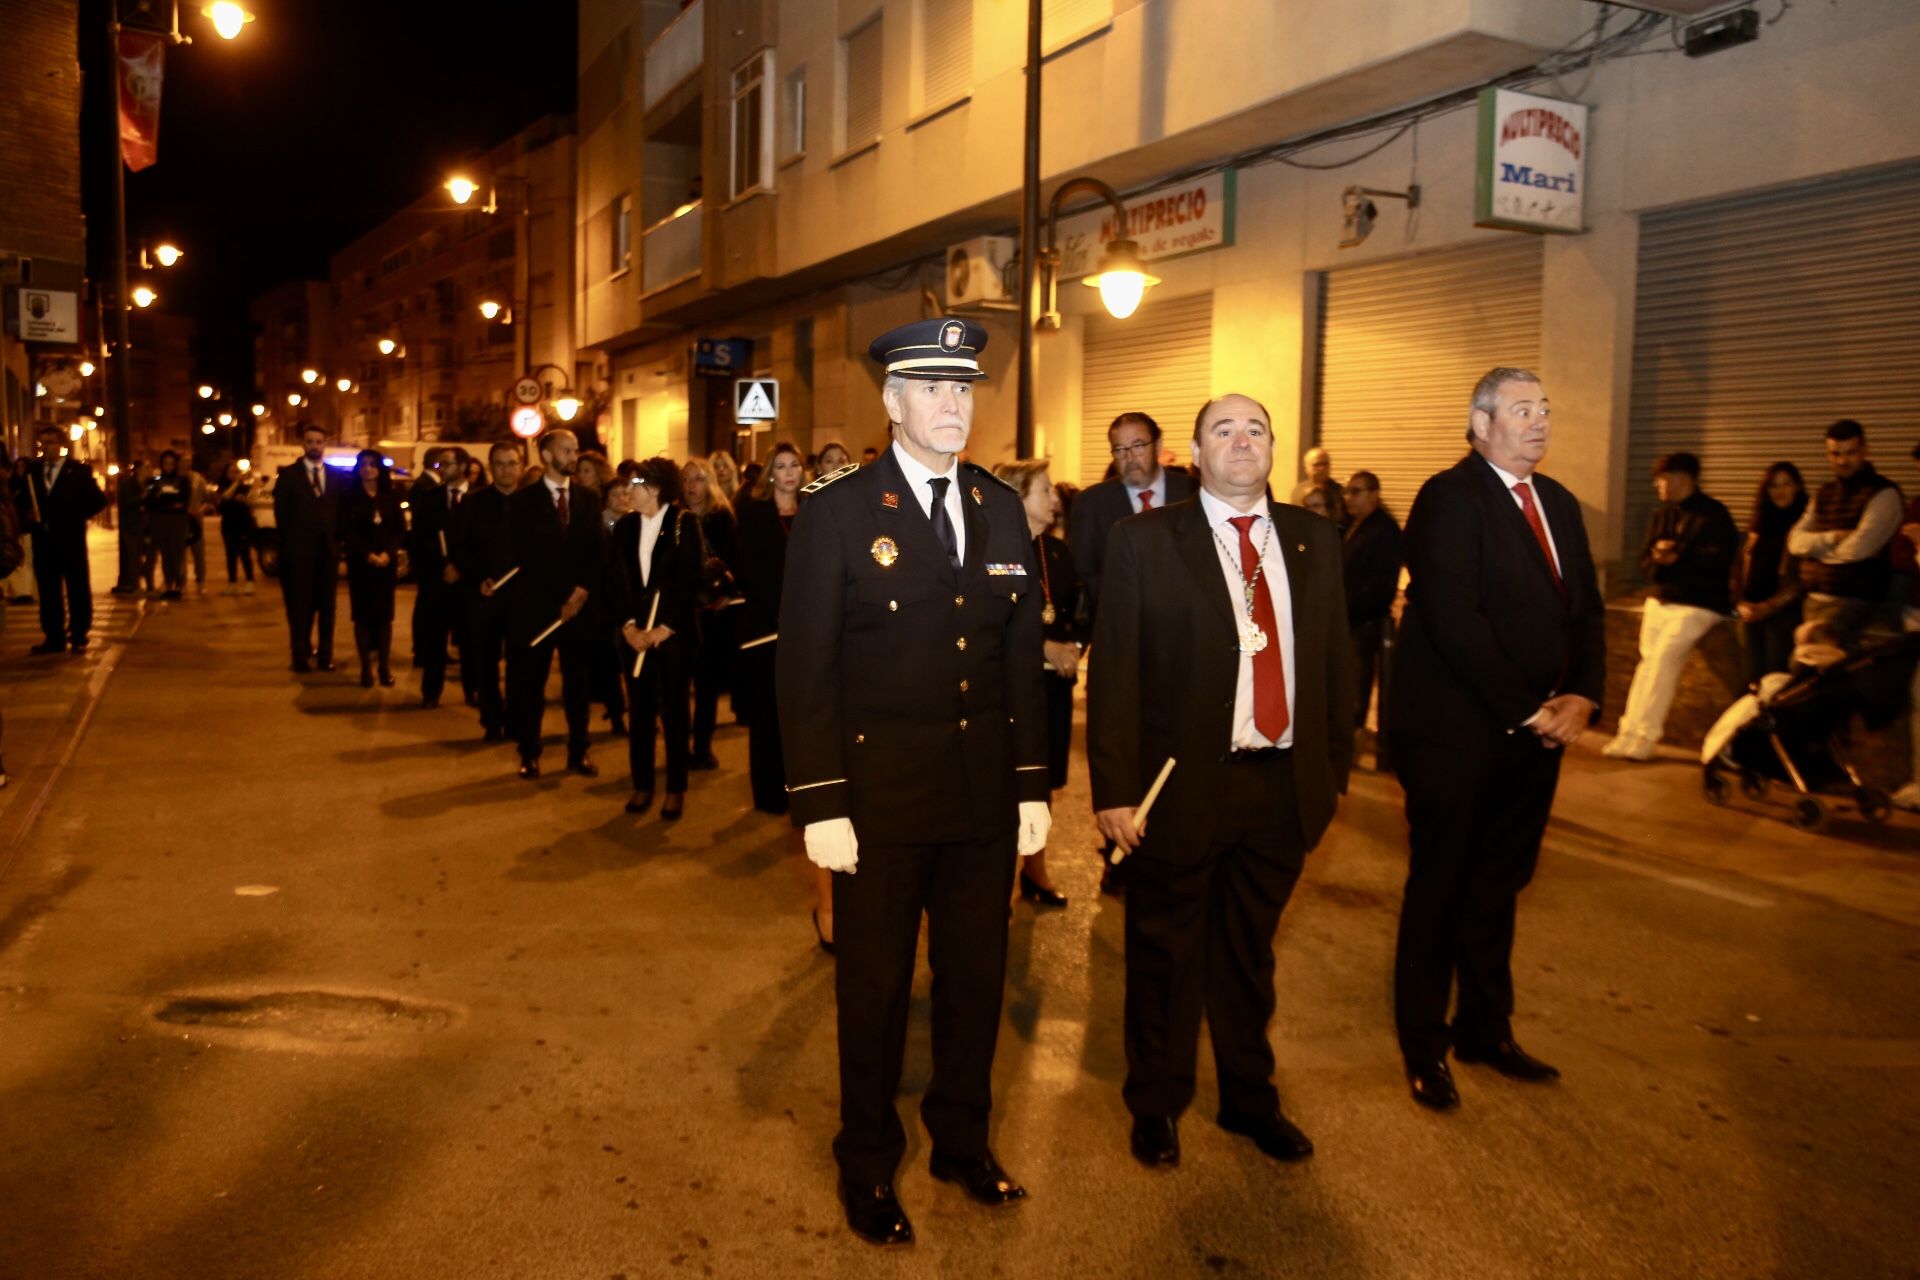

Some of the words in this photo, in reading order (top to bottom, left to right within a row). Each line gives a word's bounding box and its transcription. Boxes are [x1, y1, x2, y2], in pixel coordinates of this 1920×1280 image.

[1500, 108, 1581, 160] MULTIPRECIO
[1500, 162, 1576, 193] Mari
[1152, 236, 1168, 253] de
[1172, 228, 1215, 249] regalo
